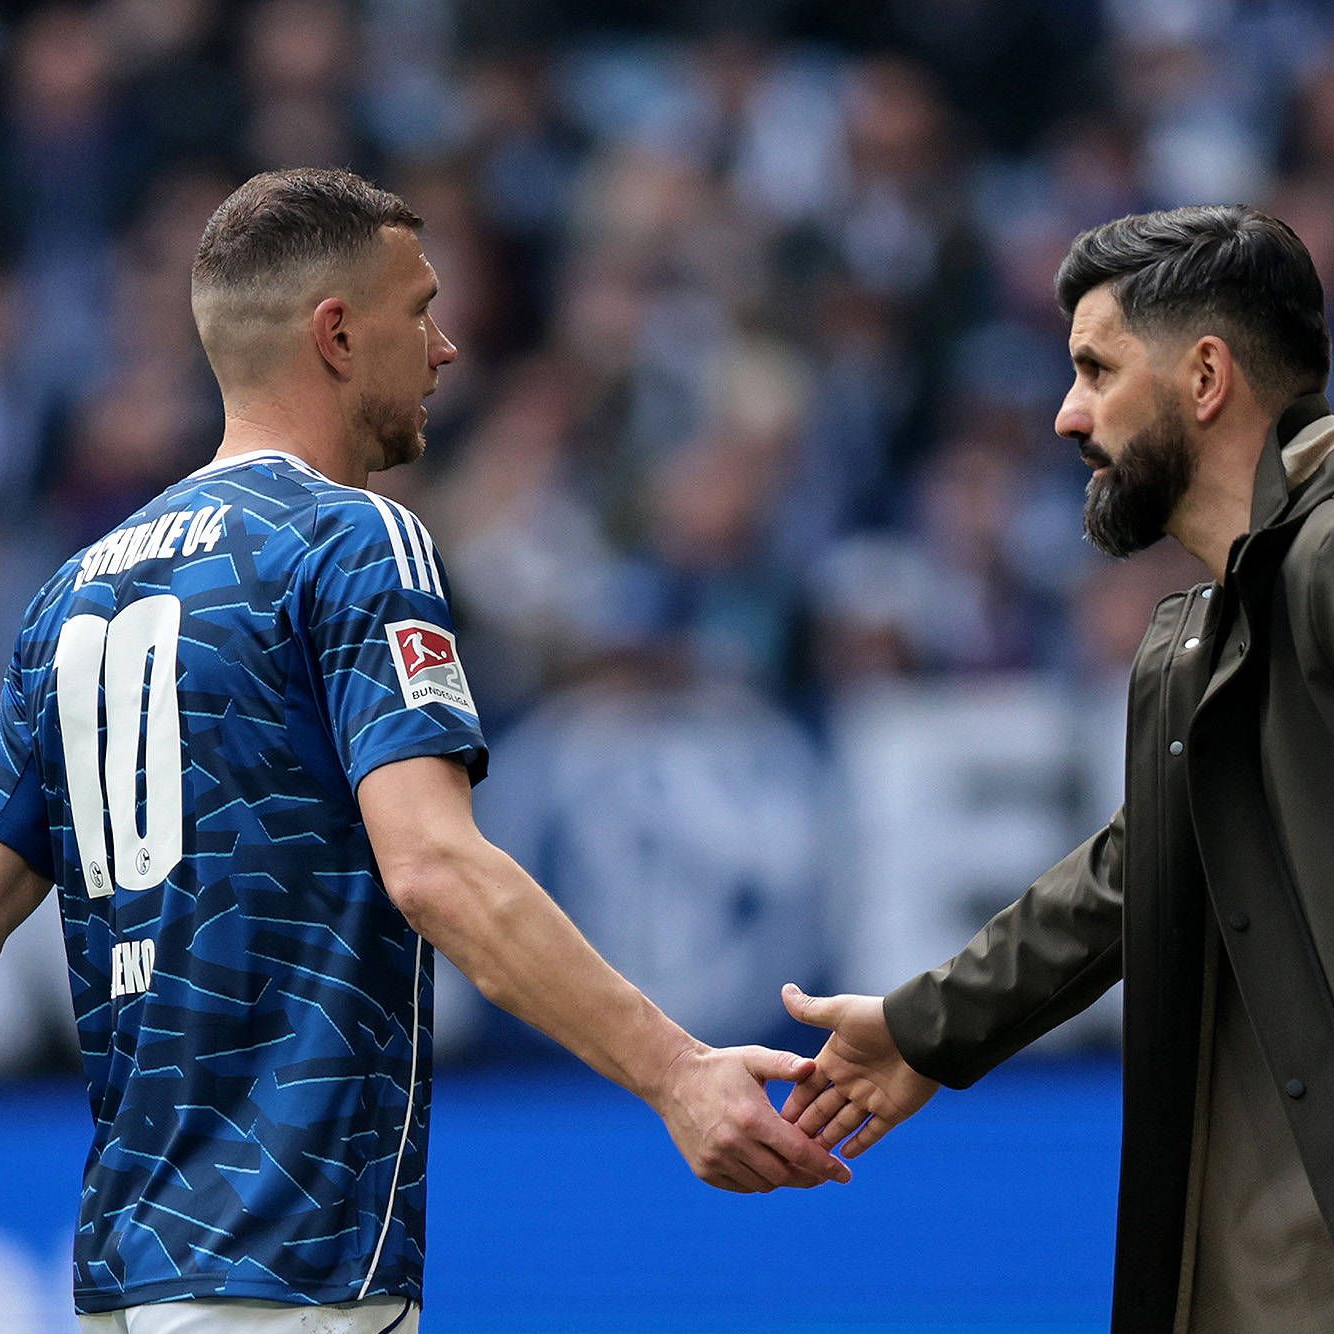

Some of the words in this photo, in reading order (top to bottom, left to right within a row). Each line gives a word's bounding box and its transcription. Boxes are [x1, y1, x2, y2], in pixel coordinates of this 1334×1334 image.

[181, 505, 233, 557] 04
[412, 686, 470, 708] BUNDESLIGA
[52, 594, 183, 899] 10
[110, 938, 155, 999] EKO
